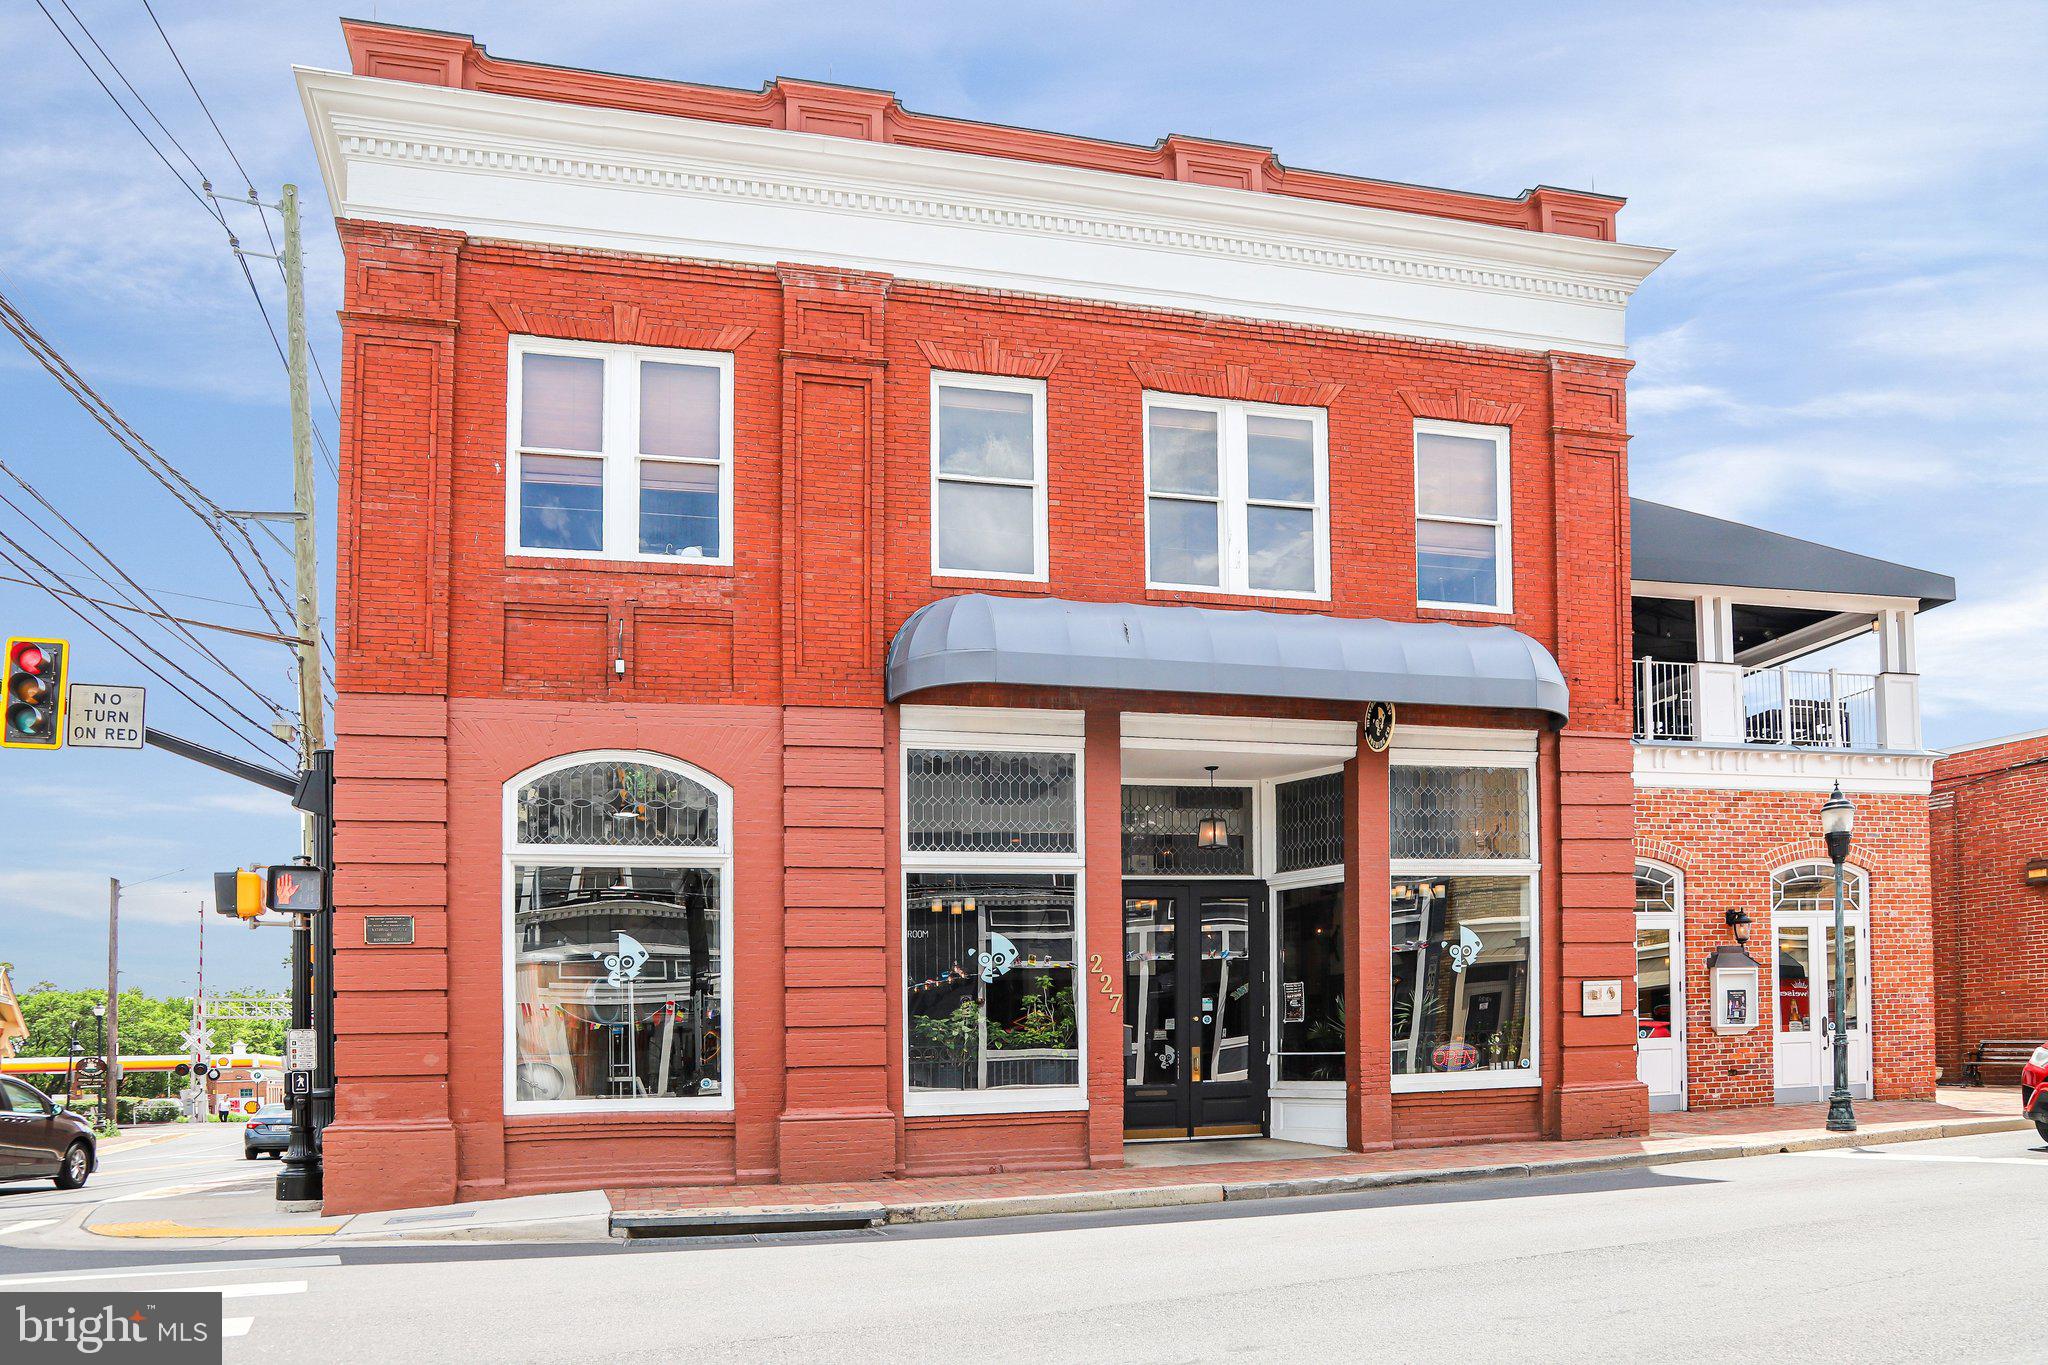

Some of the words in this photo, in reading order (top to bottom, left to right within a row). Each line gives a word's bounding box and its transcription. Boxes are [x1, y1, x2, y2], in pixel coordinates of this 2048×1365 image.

[94, 692, 122, 706] NO
[84, 709, 129, 723] TURN
[74, 726, 96, 740] ON
[105, 727, 138, 742] RED
[907, 930, 929, 938] ROOM
[1433, 1049, 1476, 1066] OPEN
